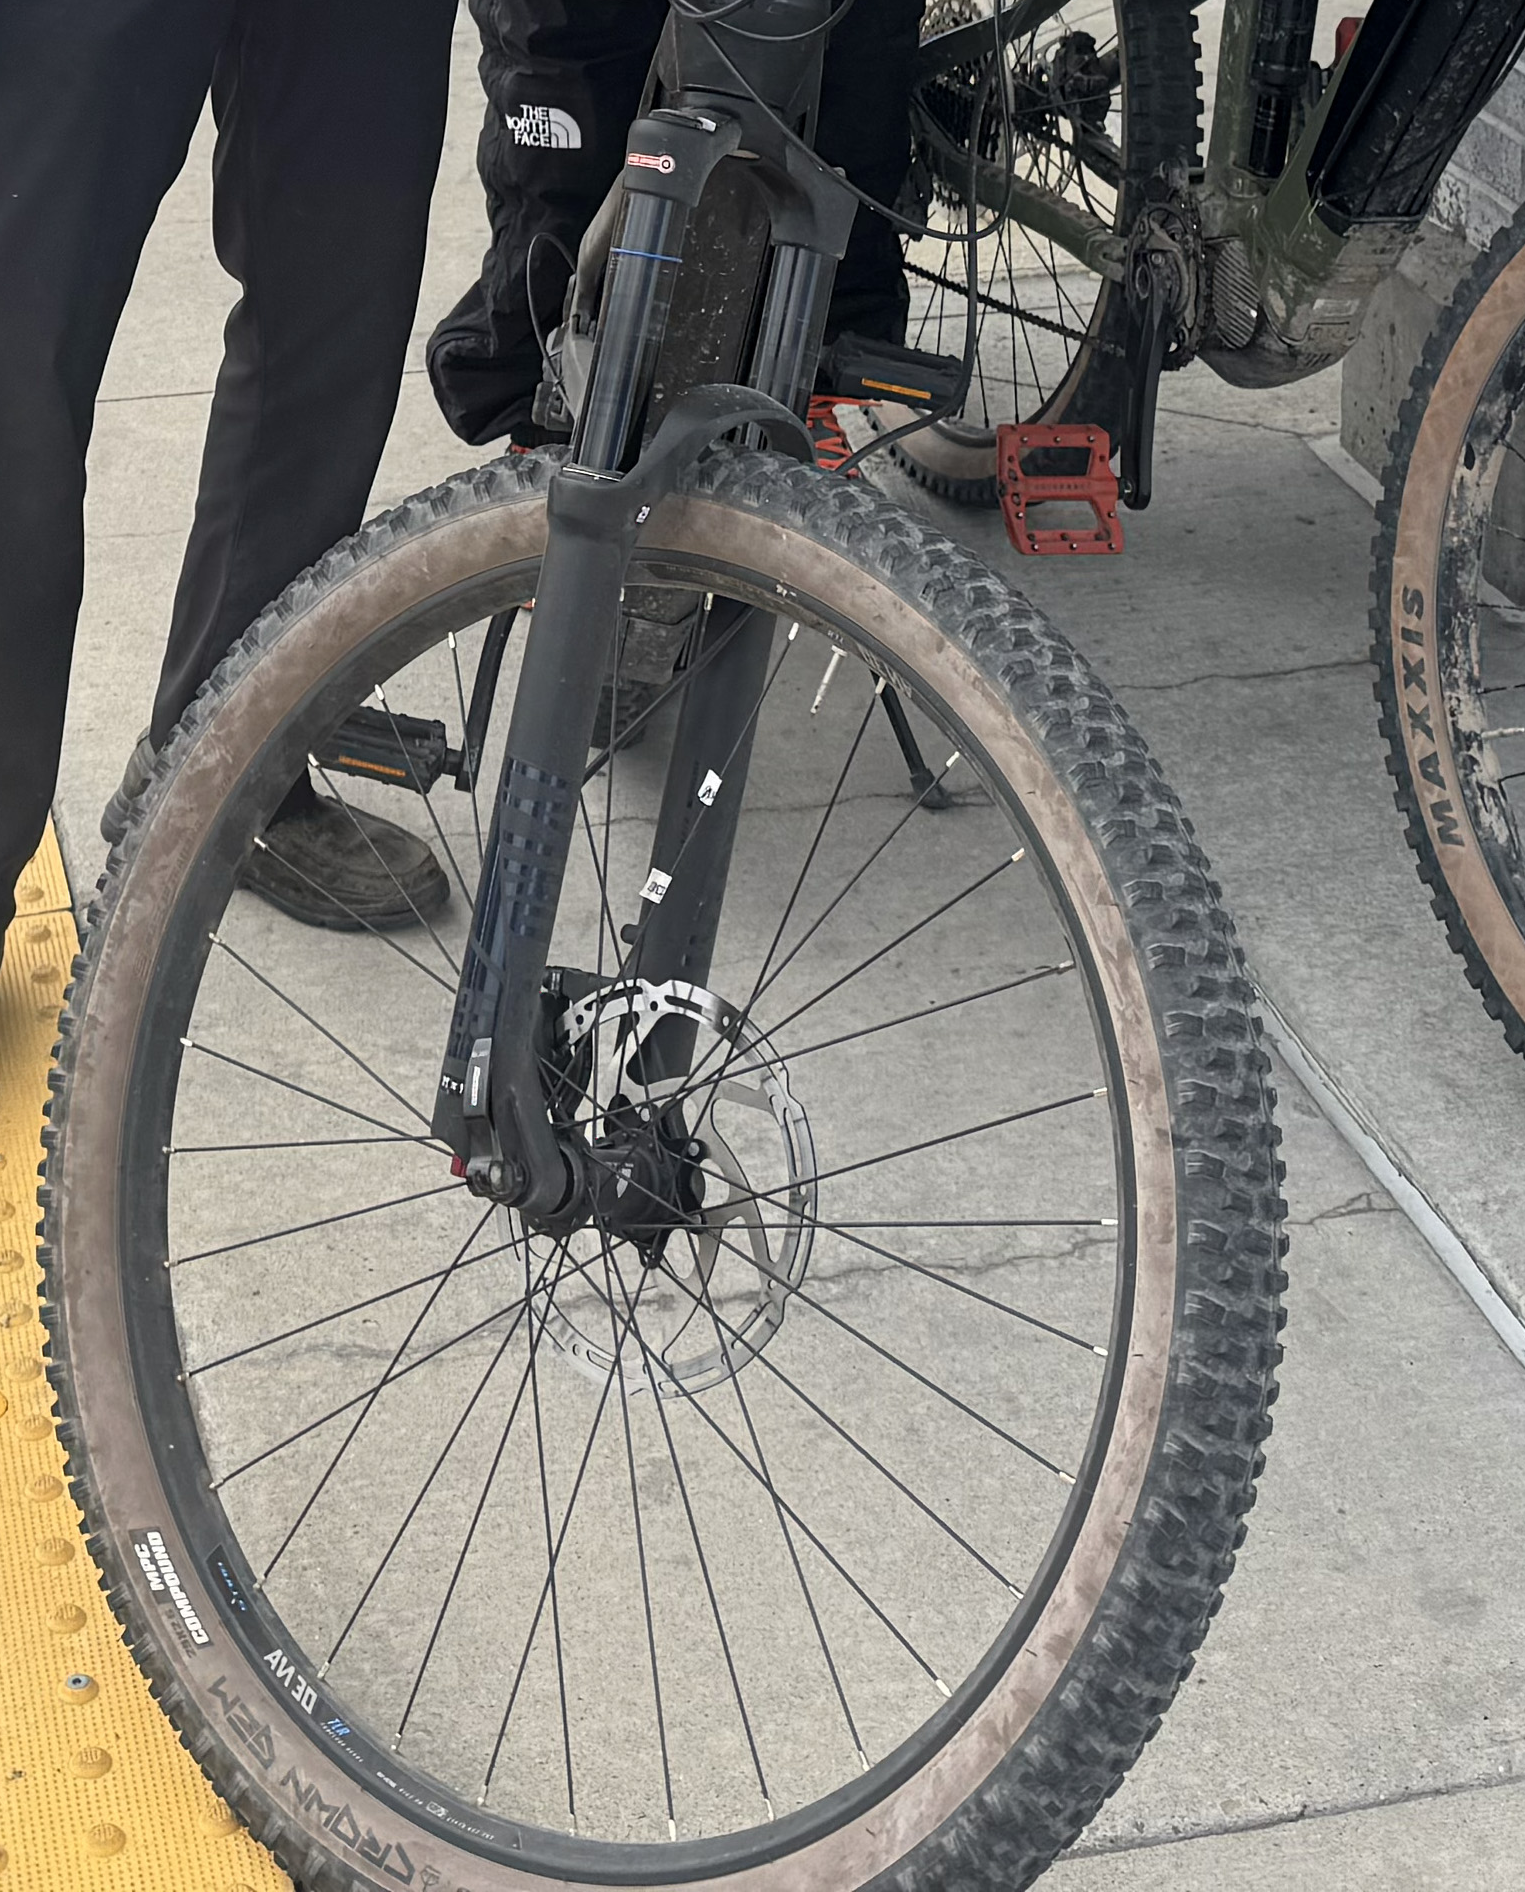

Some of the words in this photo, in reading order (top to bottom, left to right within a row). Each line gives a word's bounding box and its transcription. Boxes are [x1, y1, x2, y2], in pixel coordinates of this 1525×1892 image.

[519, 103, 549, 121] THE
[514, 129, 551, 147] FACE
[1400, 582, 1466, 849] MAXXIS
[133, 1542, 166, 1593] MPC
[146, 1530, 210, 1646] COMPOUND
